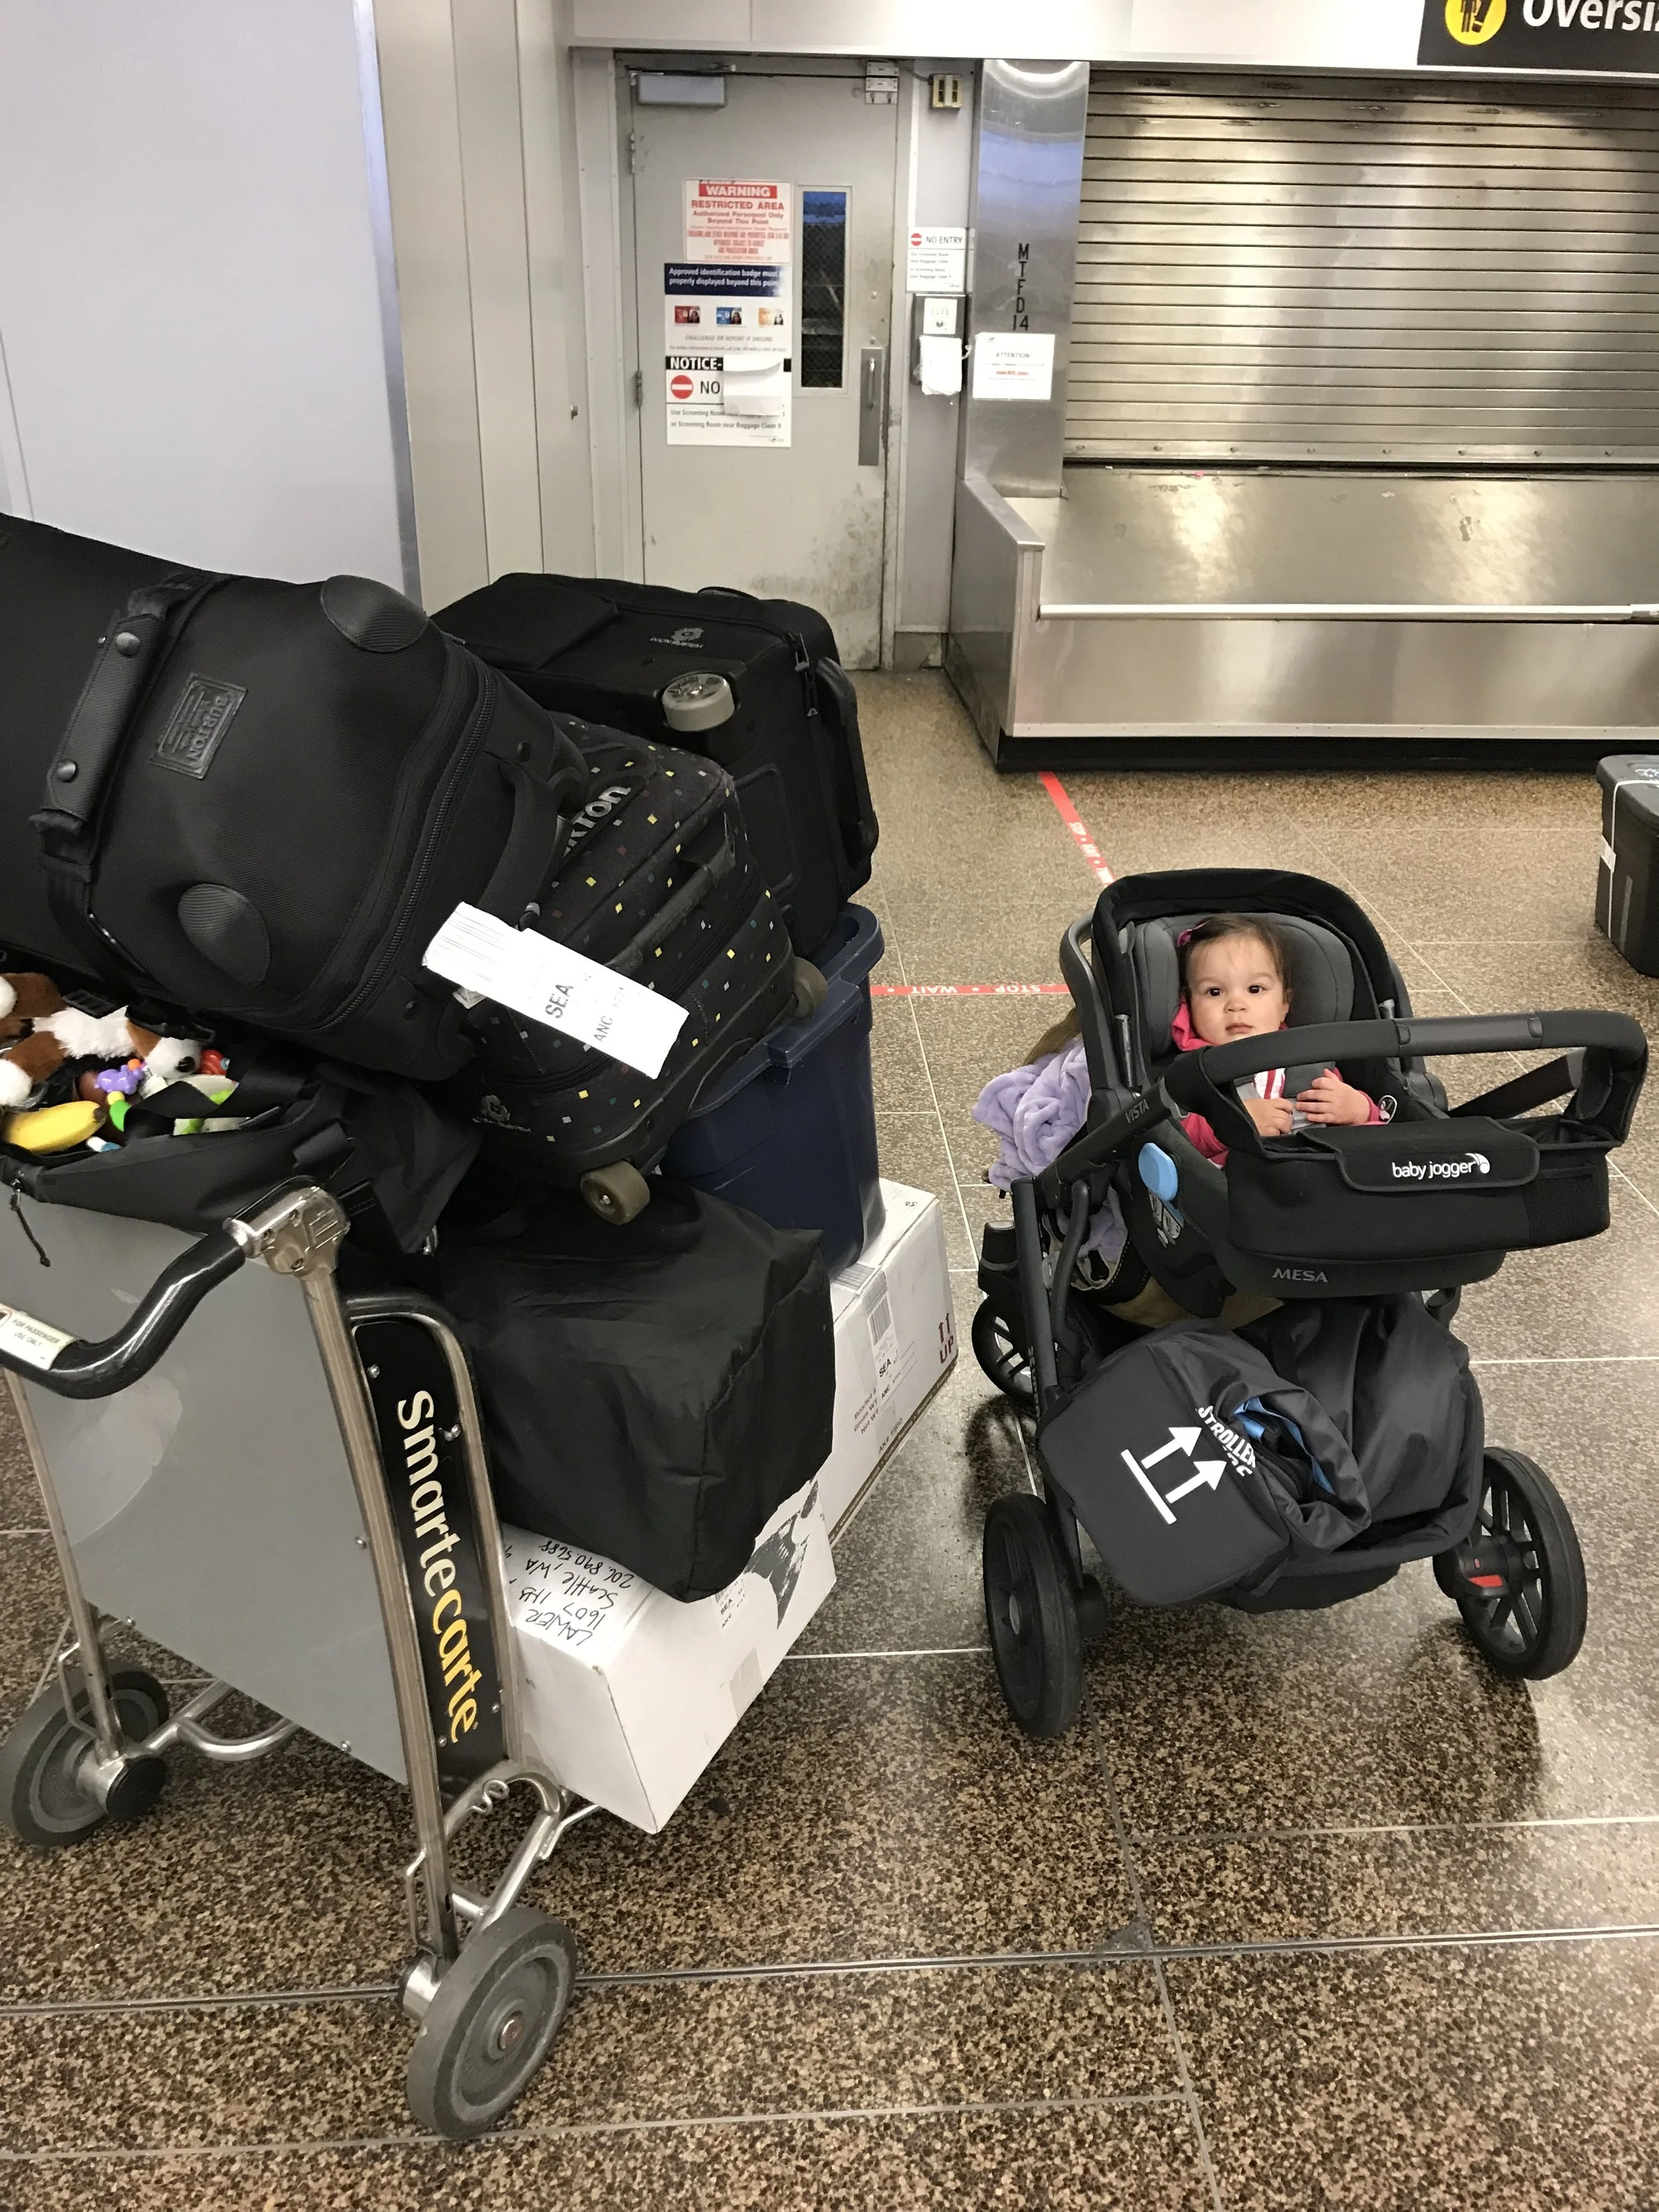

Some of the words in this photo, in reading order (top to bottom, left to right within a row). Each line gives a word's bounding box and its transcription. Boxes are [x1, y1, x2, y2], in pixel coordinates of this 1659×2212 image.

[1523, 0, 1659, 31] Oversi
[705, 186, 770, 196] WARNING
[691, 200, 753, 209] RESTRICTED
[669, 267, 699, 276] Approved
[742, 269, 761, 278] badge
[700, 381, 721, 394] NO
[912, 986, 957, 994] WAIT
[995, 984, 1041, 994] STOP
[545, 984, 574, 1019] SEA
[593, 1016, 613, 1043] ANC
[1125, 1098, 1149, 1124] VISTA
[1392, 1161, 1427, 1180] baby
[1428, 1161, 1477, 1179] jogger
[1271, 1268, 1328, 1282] MESA
[12, 1319, 26, 1327] FOR
[25, 1325, 61, 1344] PASSENGER
[940, 1335, 954, 1364] UP
[879, 1358, 891, 1377] SEA
[881, 1384, 891, 1400] ANC
[526, 1558, 551, 1579] WA
[720, 1598, 733, 1615] SEA
